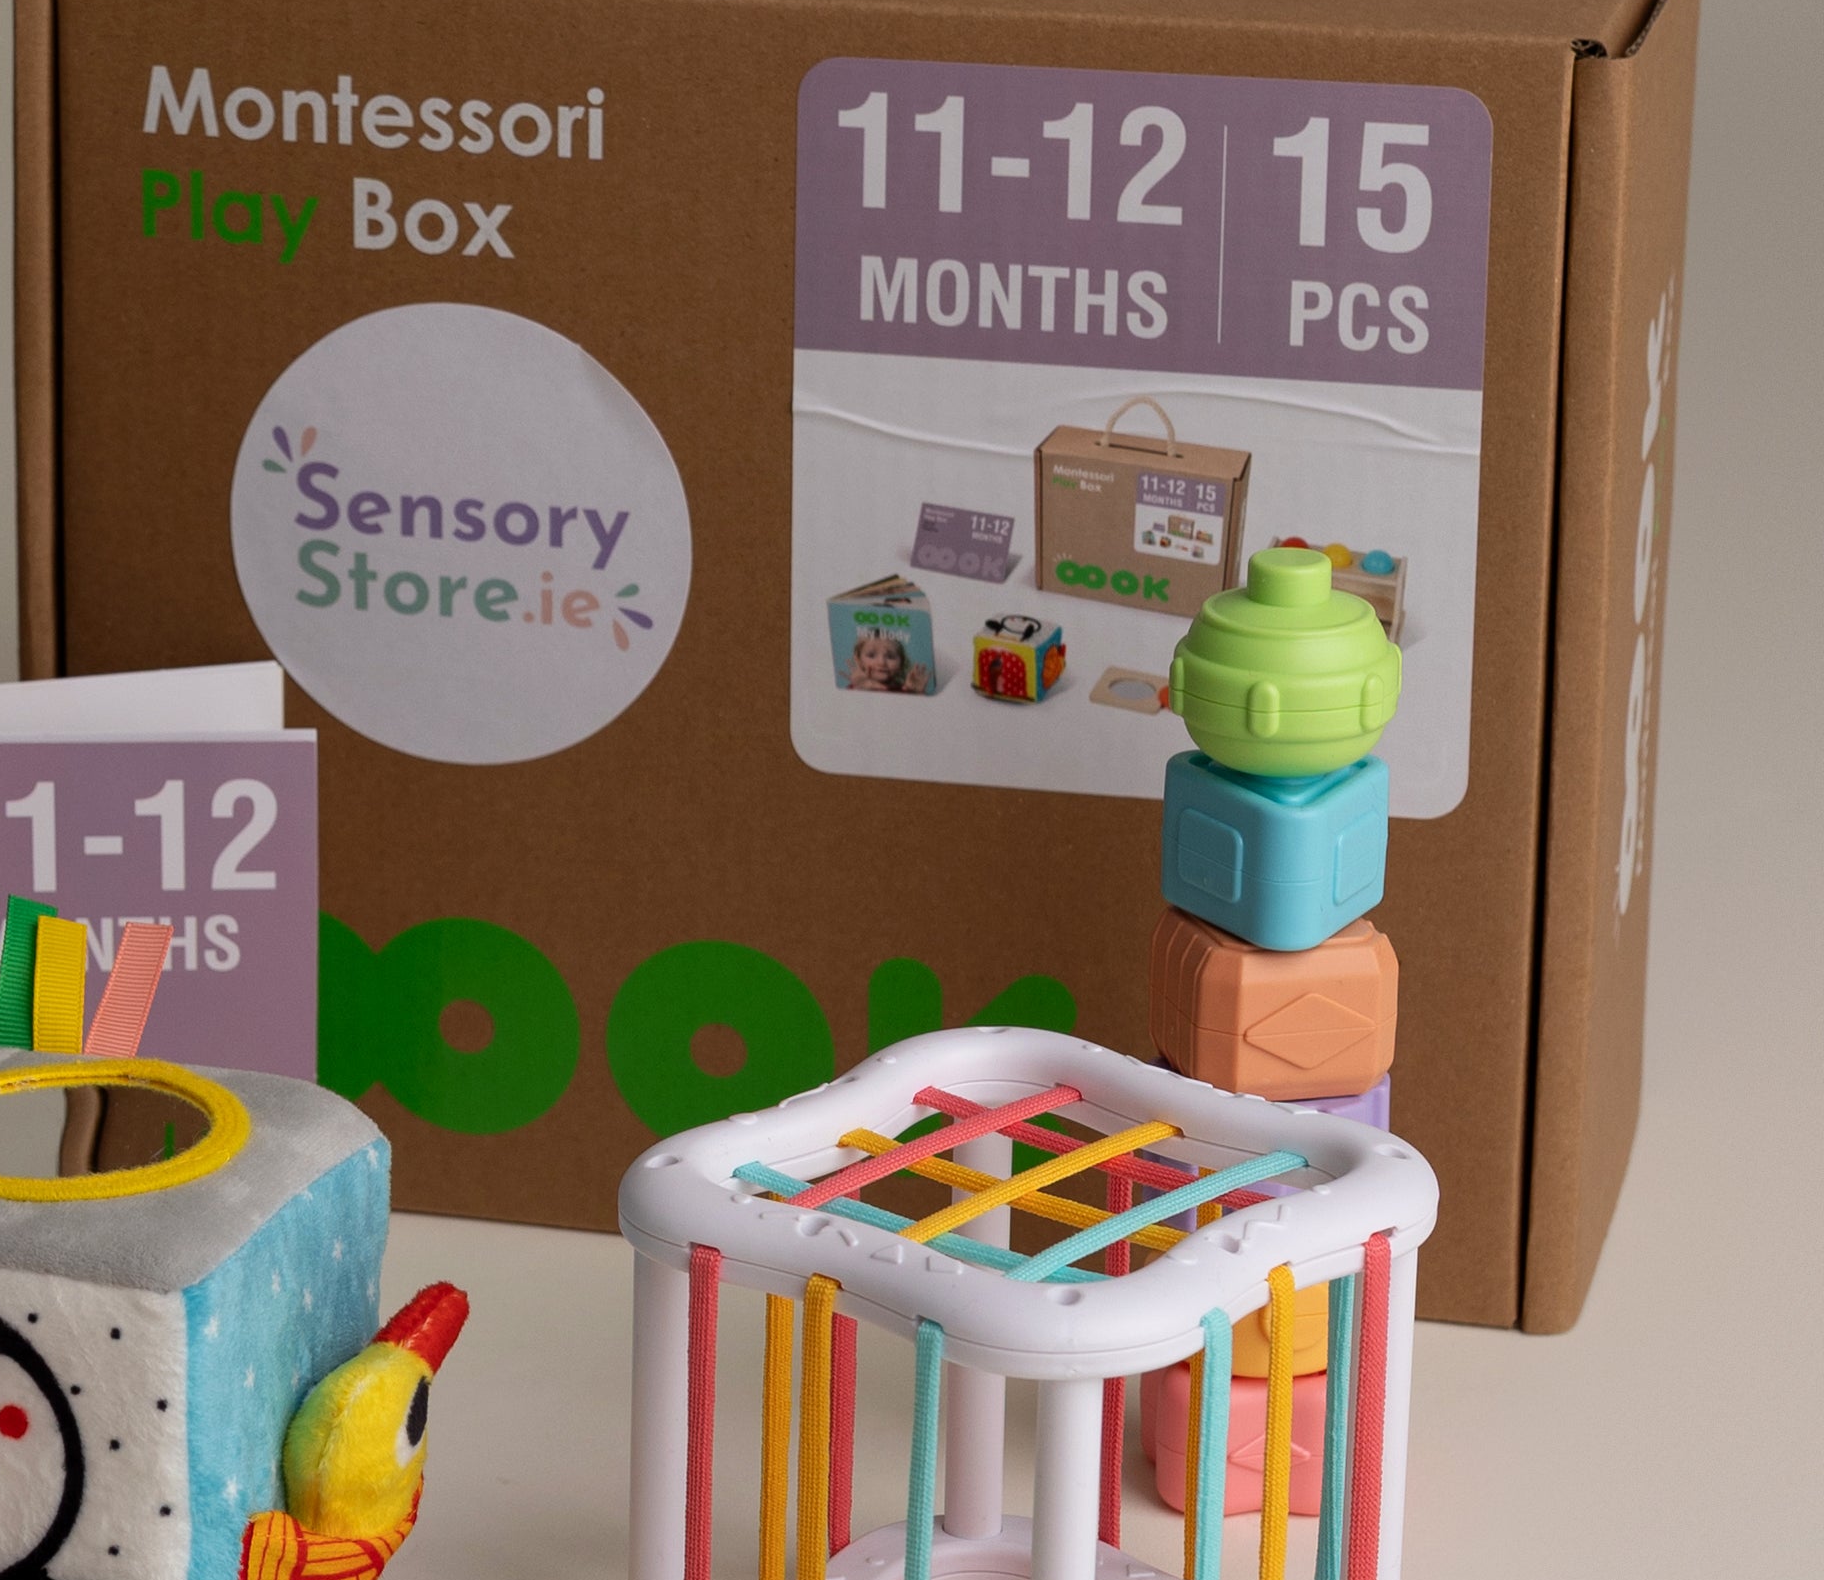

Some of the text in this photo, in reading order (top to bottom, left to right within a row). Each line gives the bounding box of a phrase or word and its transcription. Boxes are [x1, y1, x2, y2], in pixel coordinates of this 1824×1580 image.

[142, 65, 605, 160] Montessori
[141, 169, 515, 263] Play Box
[838, 91, 1433, 254] 11-12 15
[859, 255, 1430, 354] MONTHS PCS
[294, 462, 630, 570] Sensory
[971, 514, 1010, 536] 11-12
[1140, 475, 1217, 502] 11-12 15
[1142, 493, 1215, 513] MONTHS PCS
[295, 540, 600, 629] Store.ie
